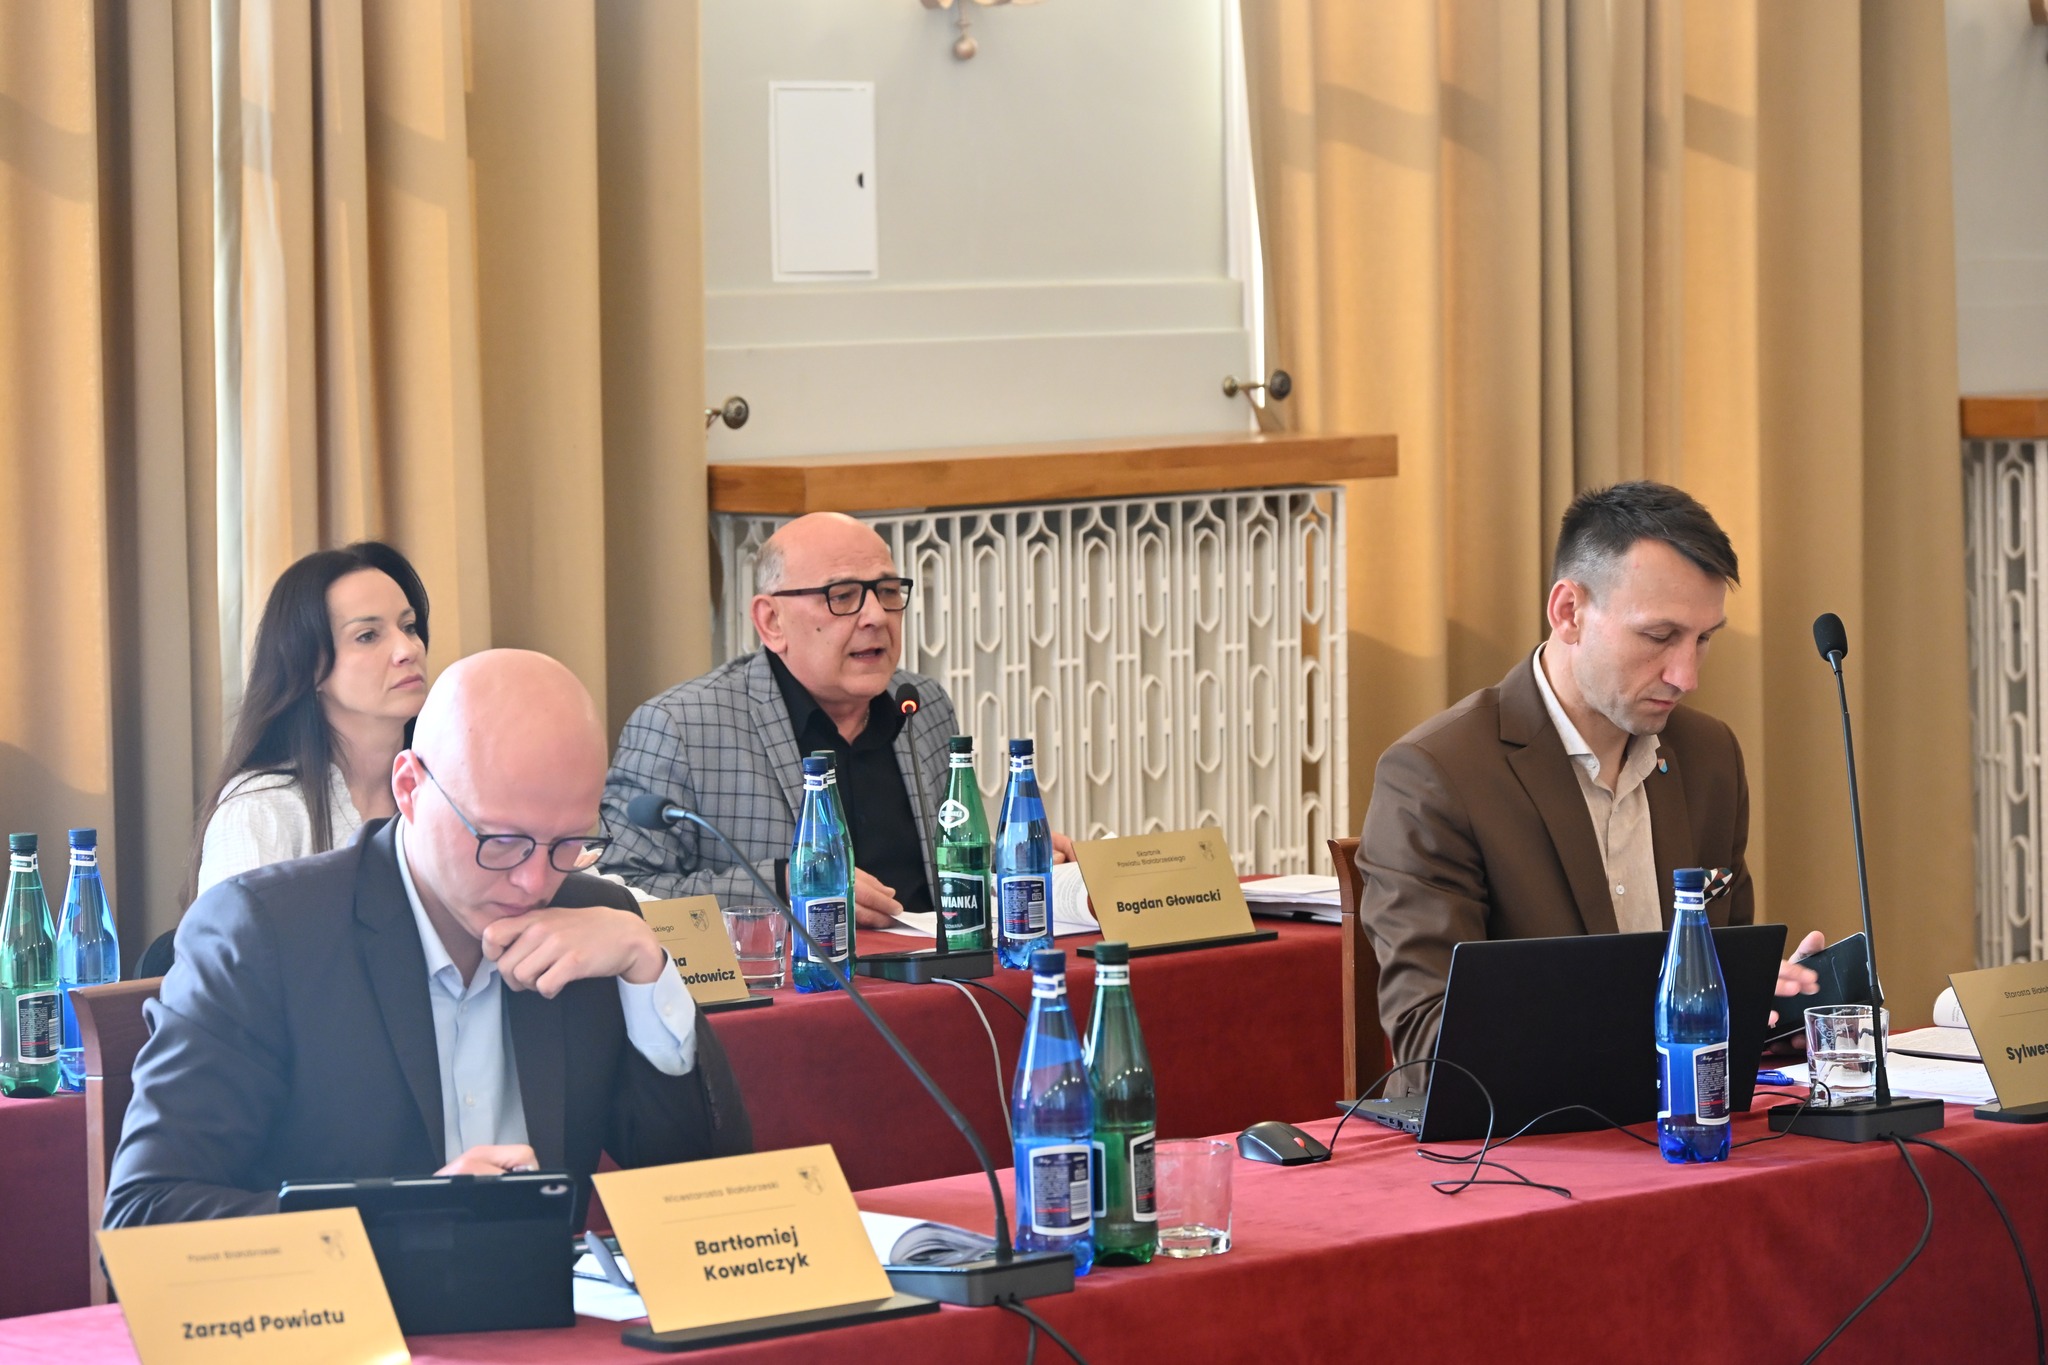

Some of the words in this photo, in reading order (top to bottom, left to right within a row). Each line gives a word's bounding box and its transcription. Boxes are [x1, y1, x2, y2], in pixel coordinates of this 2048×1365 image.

[940, 894, 978, 909] WIANKA
[1116, 897, 1164, 914] Bogdan
[1166, 889, 1222, 907] Głowacki
[680, 968, 736, 985] botowicz
[2004, 989, 2031, 999] Starosta
[695, 1225, 800, 1256] Bartłomiej
[703, 1252, 810, 1281] Kowalczyk
[182, 1315, 256, 1340] Zarząd
[259, 1309, 346, 1331] Powiatu
